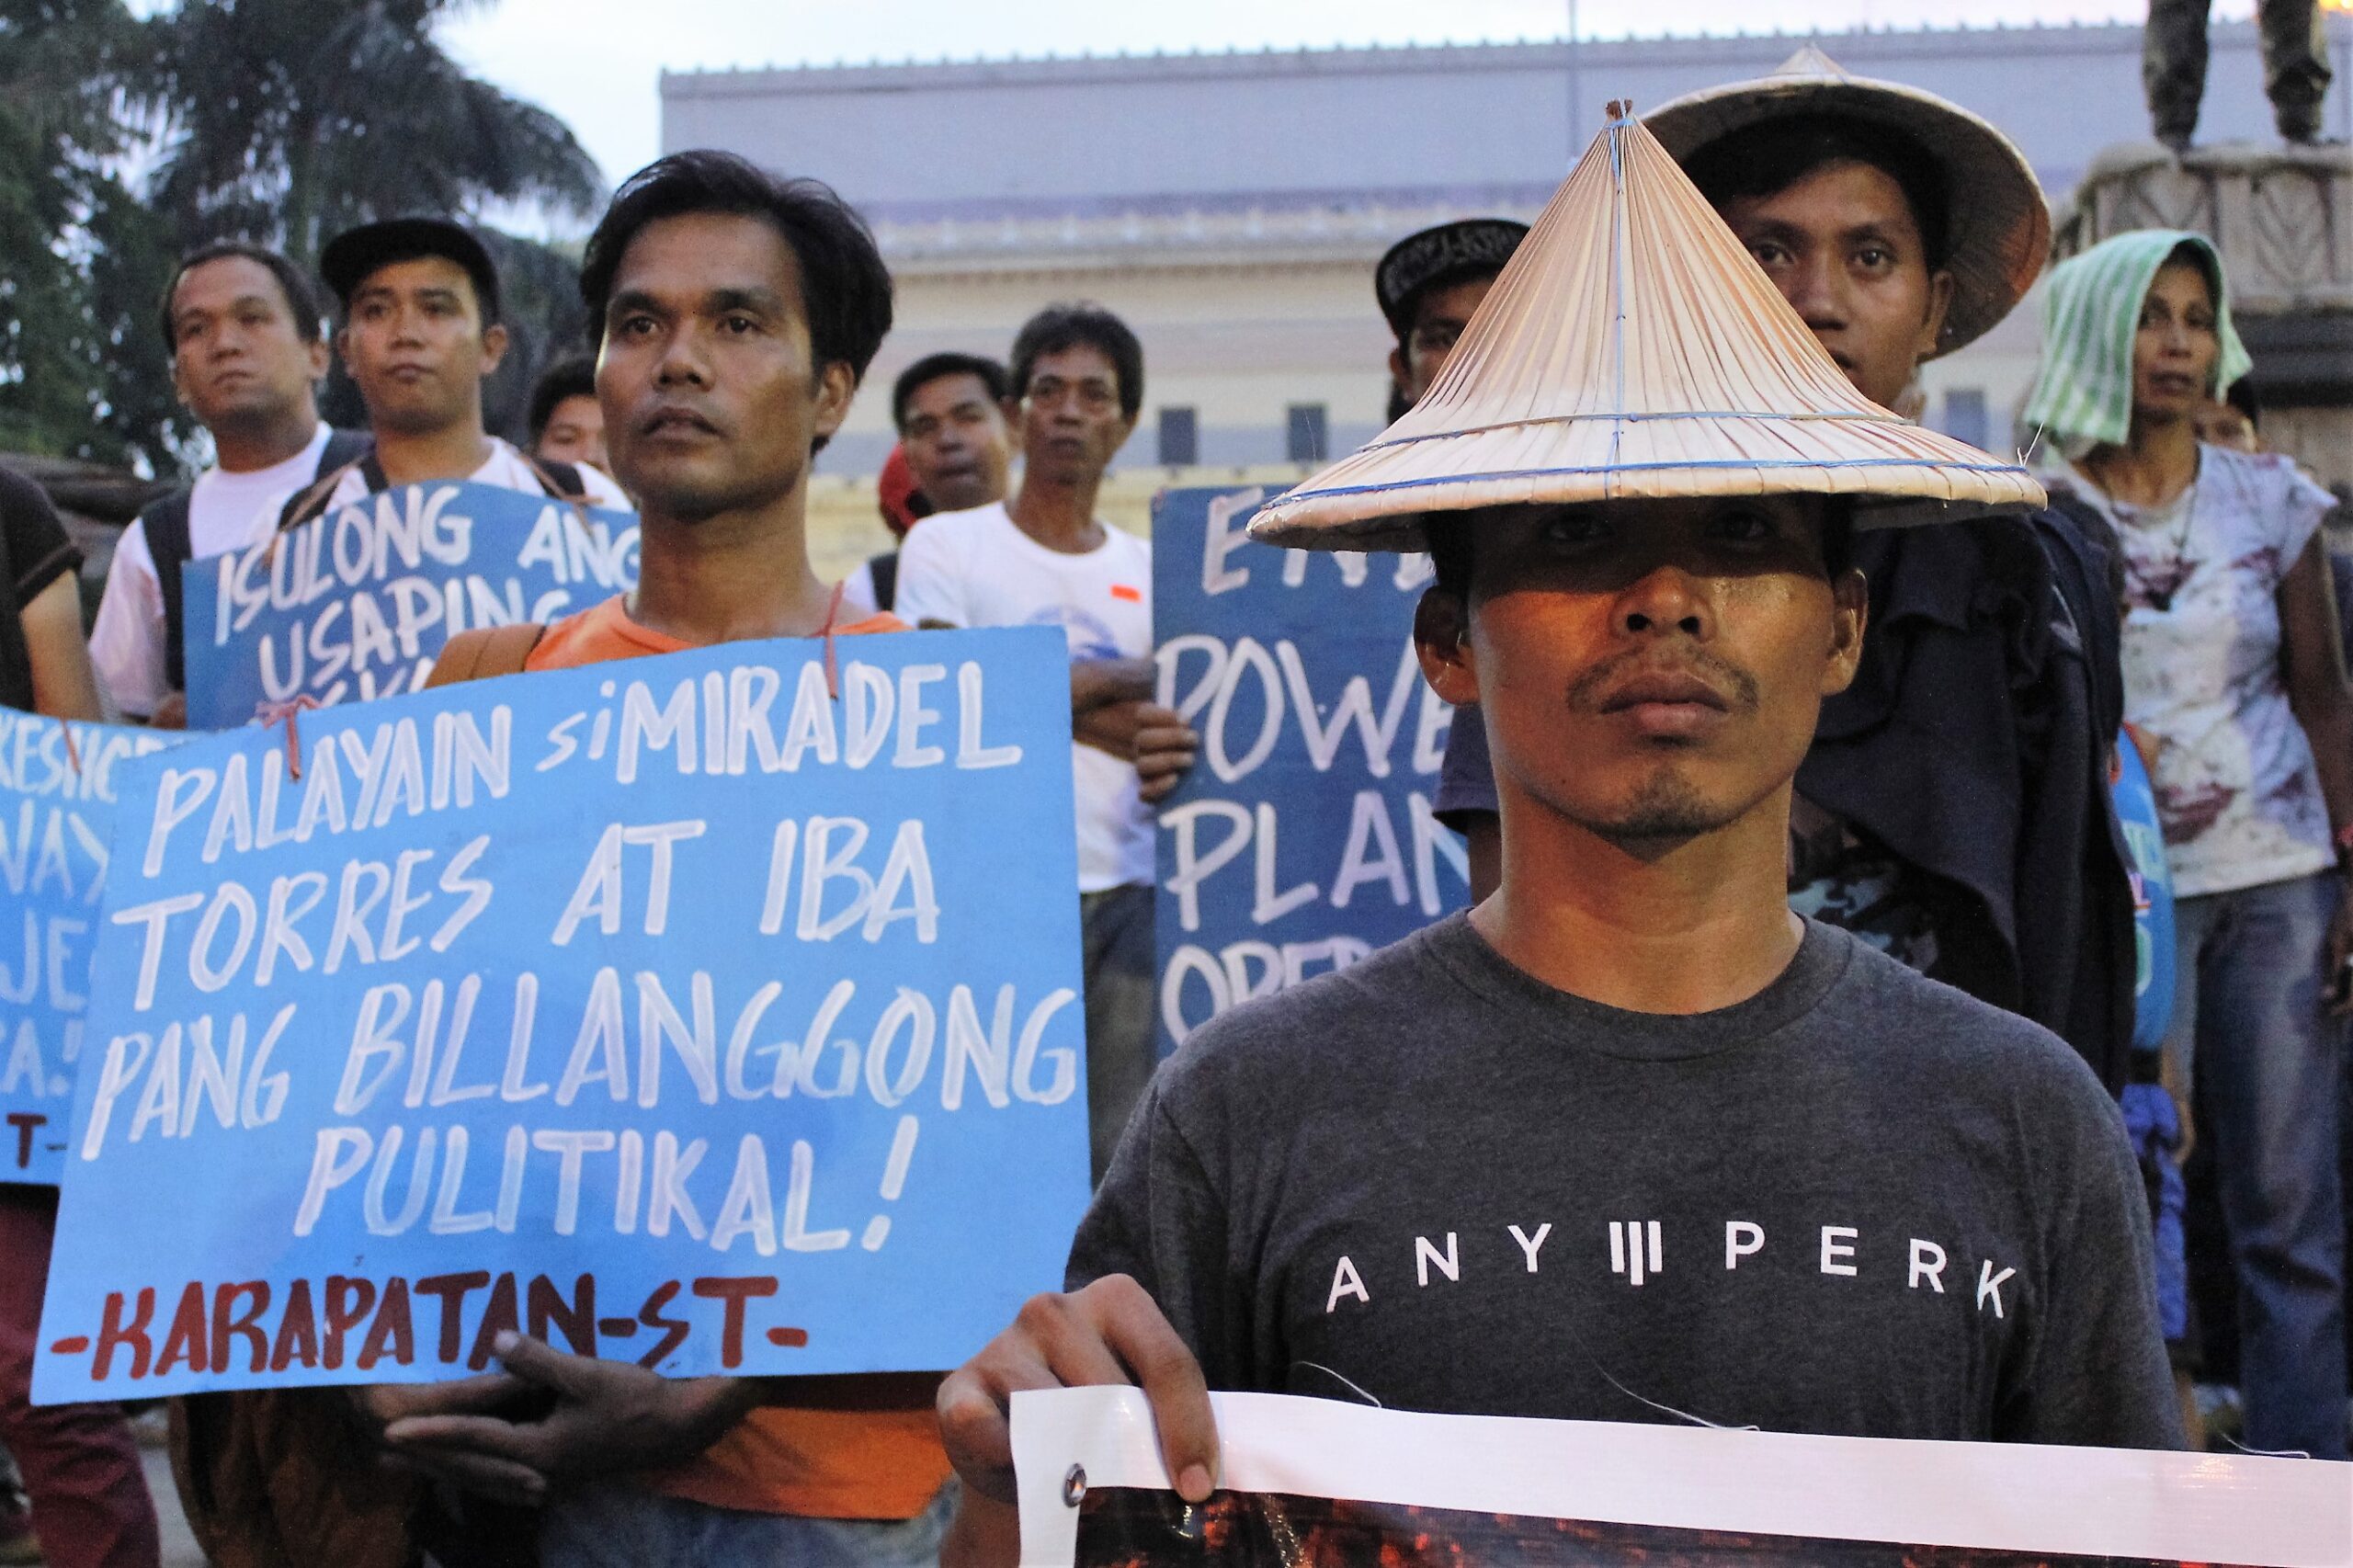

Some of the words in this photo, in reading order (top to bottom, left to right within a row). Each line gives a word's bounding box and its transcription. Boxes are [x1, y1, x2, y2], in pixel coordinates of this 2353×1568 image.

[215, 483, 472, 646] ISULONG
[517, 504, 642, 589] ANG
[143, 704, 512, 879] PALAYAIN
[111, 835, 494, 1011] TORRES
[551, 823, 707, 947] AT
[758, 815, 941, 945] IBA
[81, 1004, 297, 1161] PANG
[334, 966, 1077, 1116] BILLANGGONG
[293, 1114, 919, 1256] PULITIKAL!
[1325, 1221, 1552, 1313] ANY
[1724, 1220, 2017, 1319] PERK
